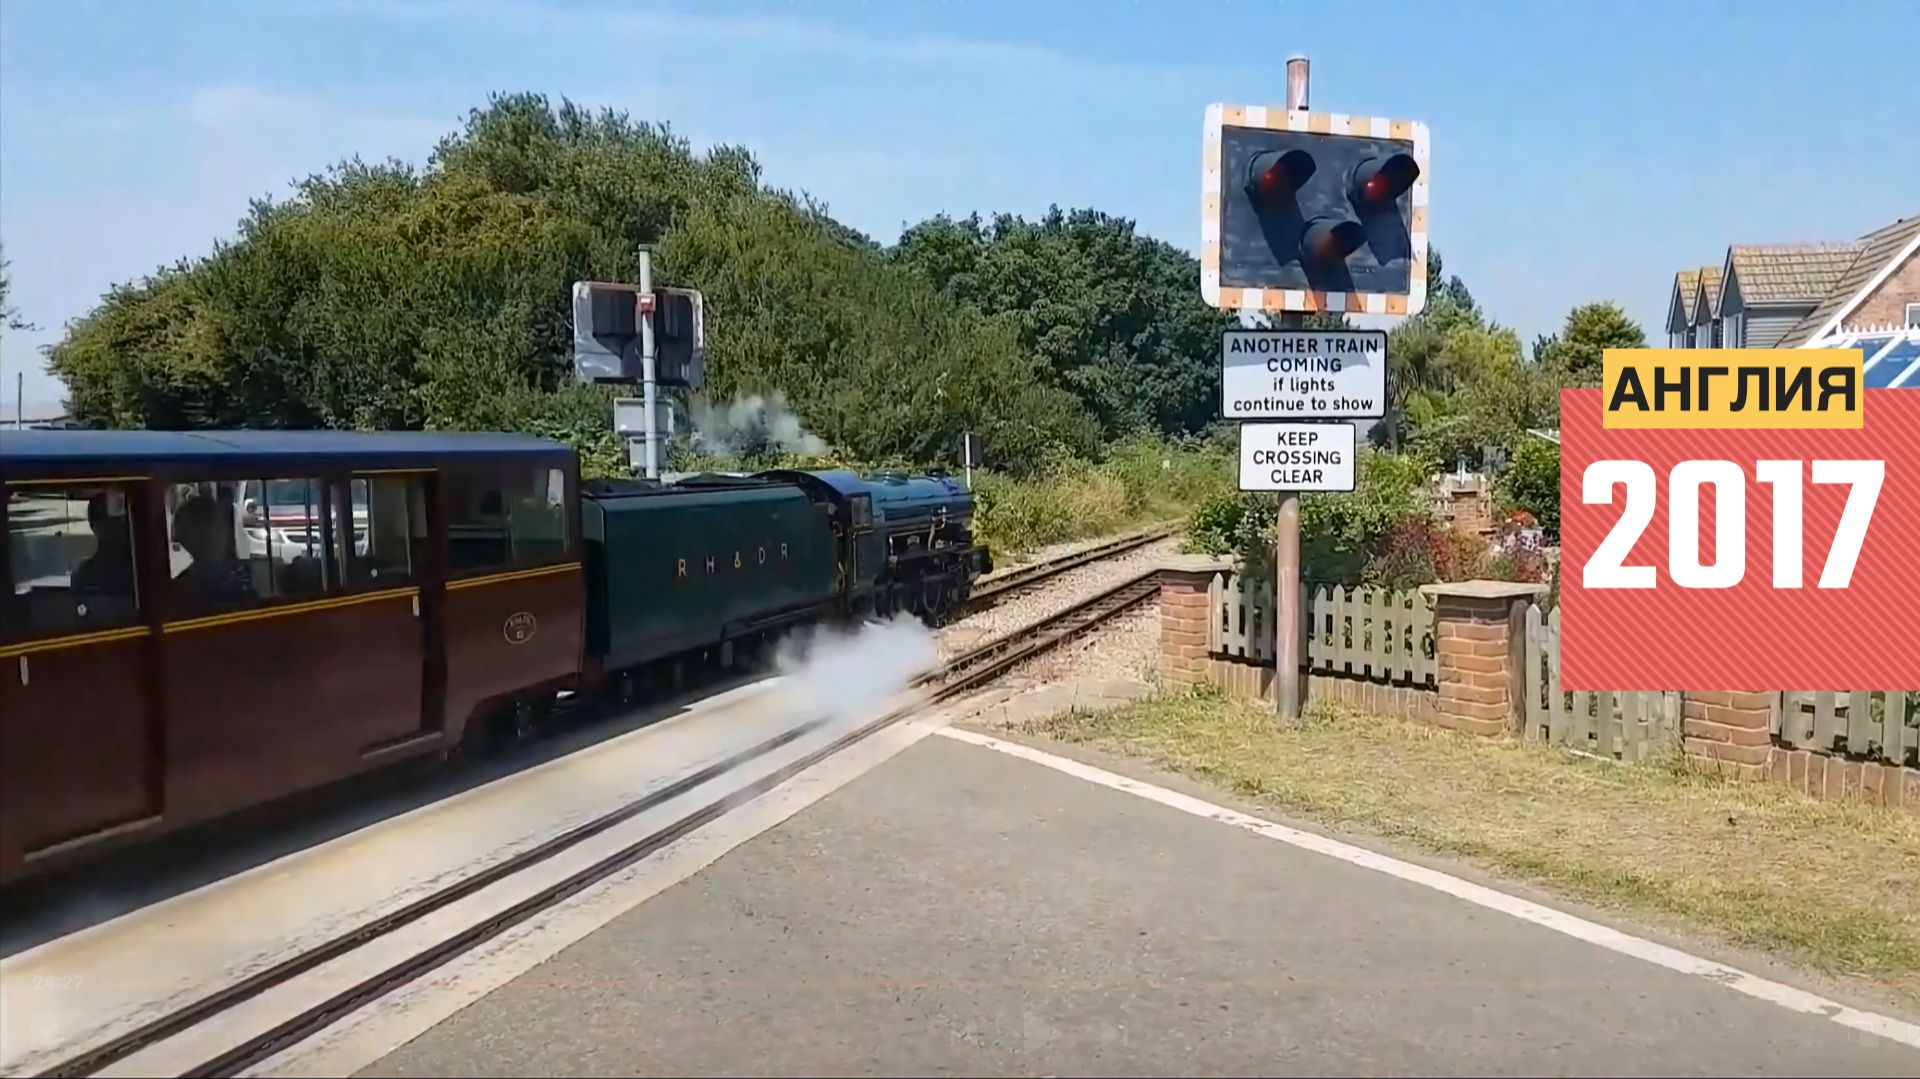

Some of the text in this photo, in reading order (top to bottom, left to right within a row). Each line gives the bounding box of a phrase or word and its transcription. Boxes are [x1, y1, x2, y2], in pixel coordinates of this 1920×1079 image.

[1231, 338, 1378, 353] ANOTHER TRAIN
[1267, 358, 1342, 373] COMING
[1273, 377, 1335, 394] if lights
[1234, 397, 1373, 411] continue to show
[1277, 432, 1318, 446] KEEP
[1253, 450, 1341, 465] CROSSING
[1271, 470, 1323, 484] CLEAR
